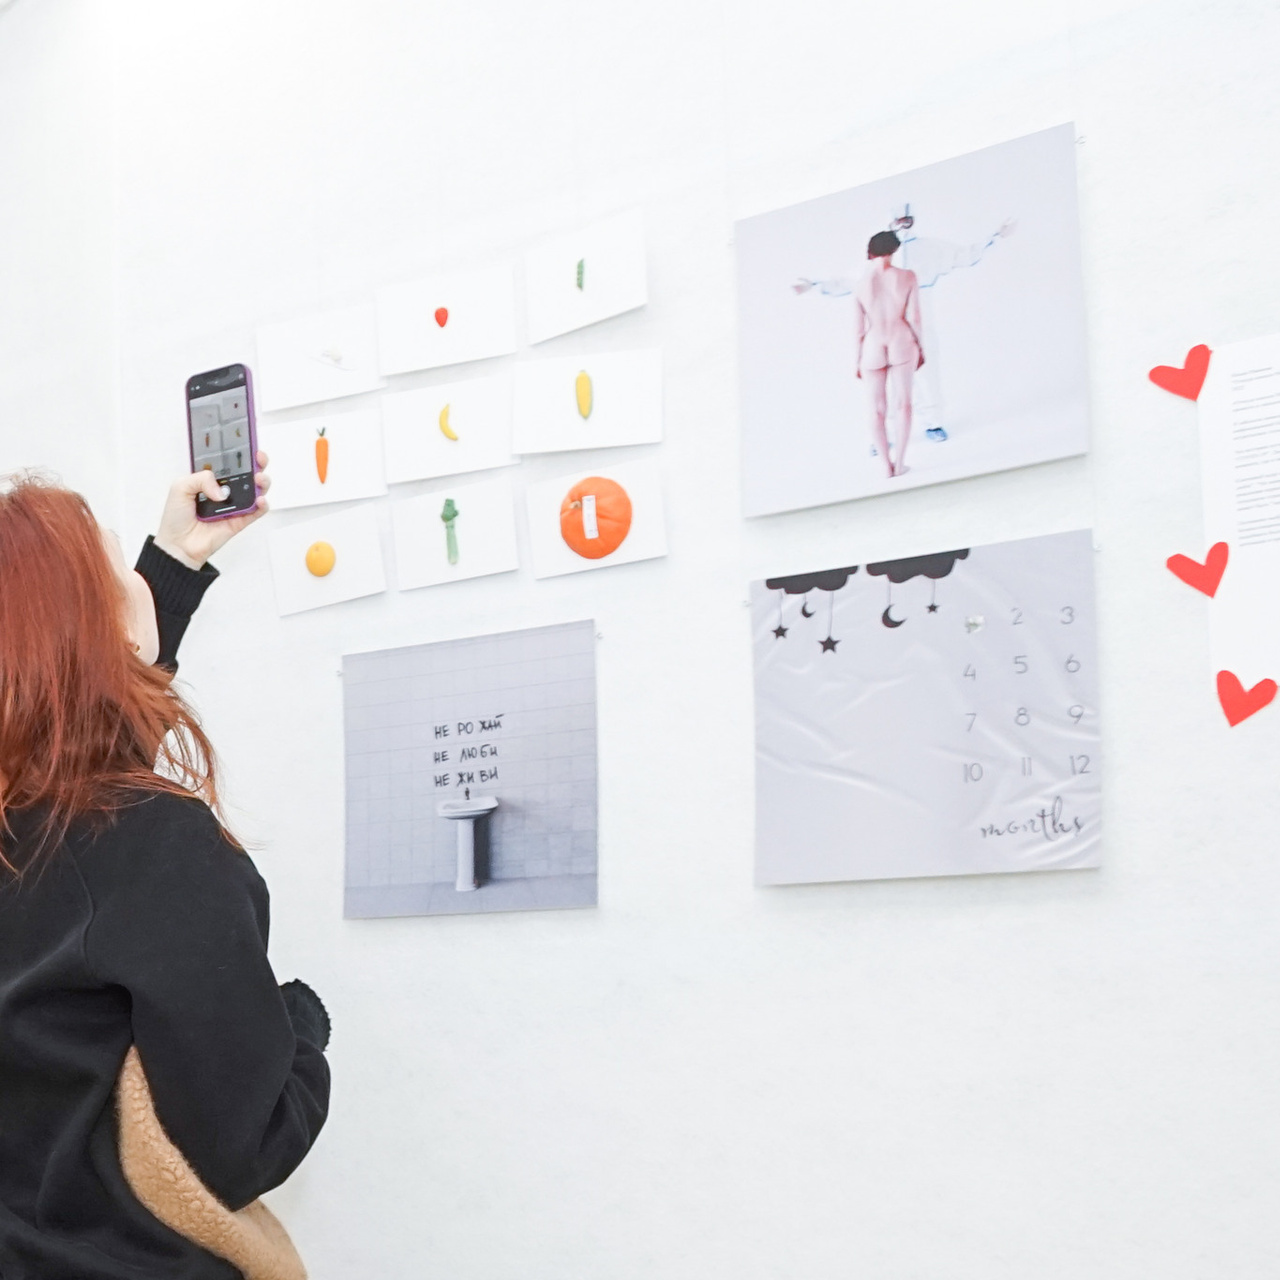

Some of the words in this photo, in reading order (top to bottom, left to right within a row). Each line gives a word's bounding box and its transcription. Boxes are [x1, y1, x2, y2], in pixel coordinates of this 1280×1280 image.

[1010, 607, 1023, 625] 2
[1060, 605, 1074, 625] 3
[963, 663, 976, 680] 4
[1014, 655, 1028, 674] 5
[1065, 653, 1081, 673] 6
[965, 712, 977, 732] 7
[1014, 706, 1031, 726] 8
[1067, 704, 1084, 725] 9
[434, 724, 450, 740] НЕ
[433, 750, 450, 764] НЕ
[963, 762, 983, 783] 10
[1021, 756, 1033, 777] 11
[1069, 754, 1091, 776] 12
[434, 773, 450, 787] НЕ
[980, 795, 1083, 841] months
